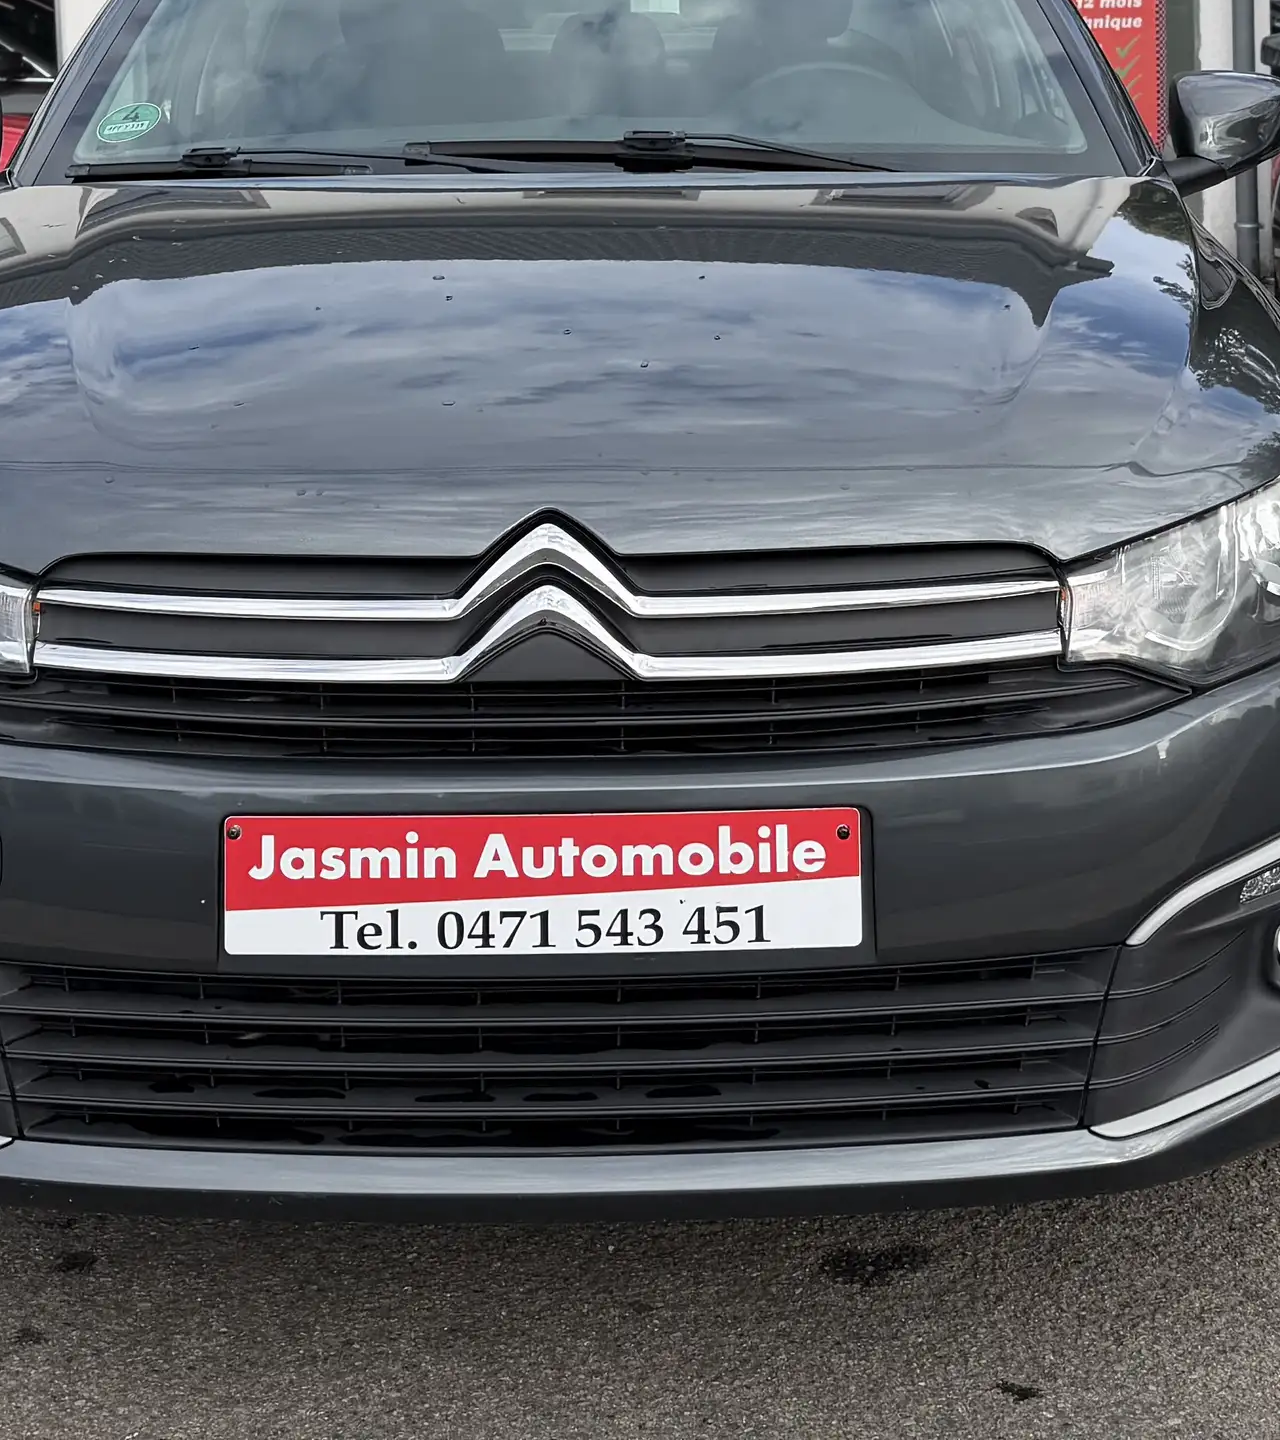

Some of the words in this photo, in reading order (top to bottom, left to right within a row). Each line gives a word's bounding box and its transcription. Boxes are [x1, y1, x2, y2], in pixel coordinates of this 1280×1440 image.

[248, 830, 457, 881] Jasmin
[473, 823, 827, 879] Automobile
[320, 908, 418, 950] Tel.
[437, 910, 557, 950] 0471
[575, 908, 664, 948] 543
[682, 904, 771, 945] 451
